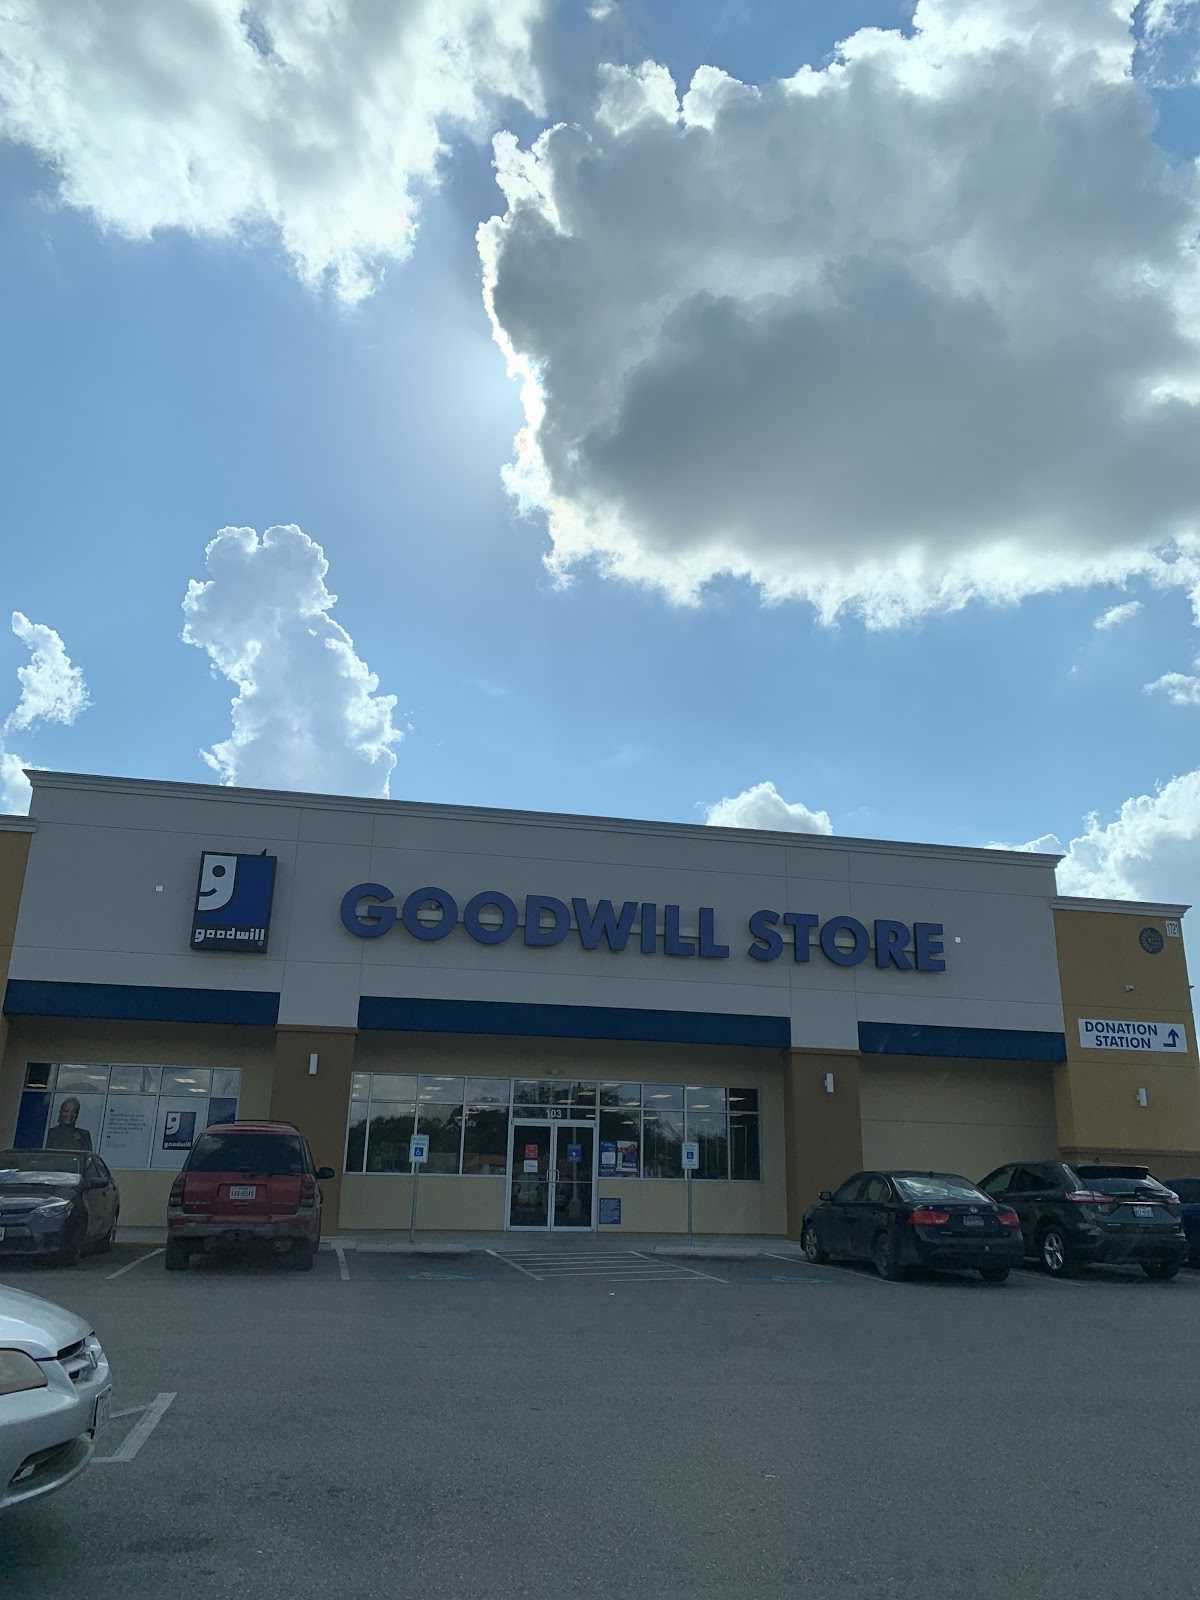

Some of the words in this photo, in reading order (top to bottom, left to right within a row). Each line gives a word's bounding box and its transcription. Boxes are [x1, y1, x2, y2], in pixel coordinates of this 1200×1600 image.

[340, 882, 730, 959] GOODWILL
[747, 909, 946, 972] STORE
[194, 928, 265, 943] goodwill
[1084, 1021, 1158, 1036] DONATION
[1095, 1035, 1151, 1049] STATION
[546, 1109, 562, 1118] 103
